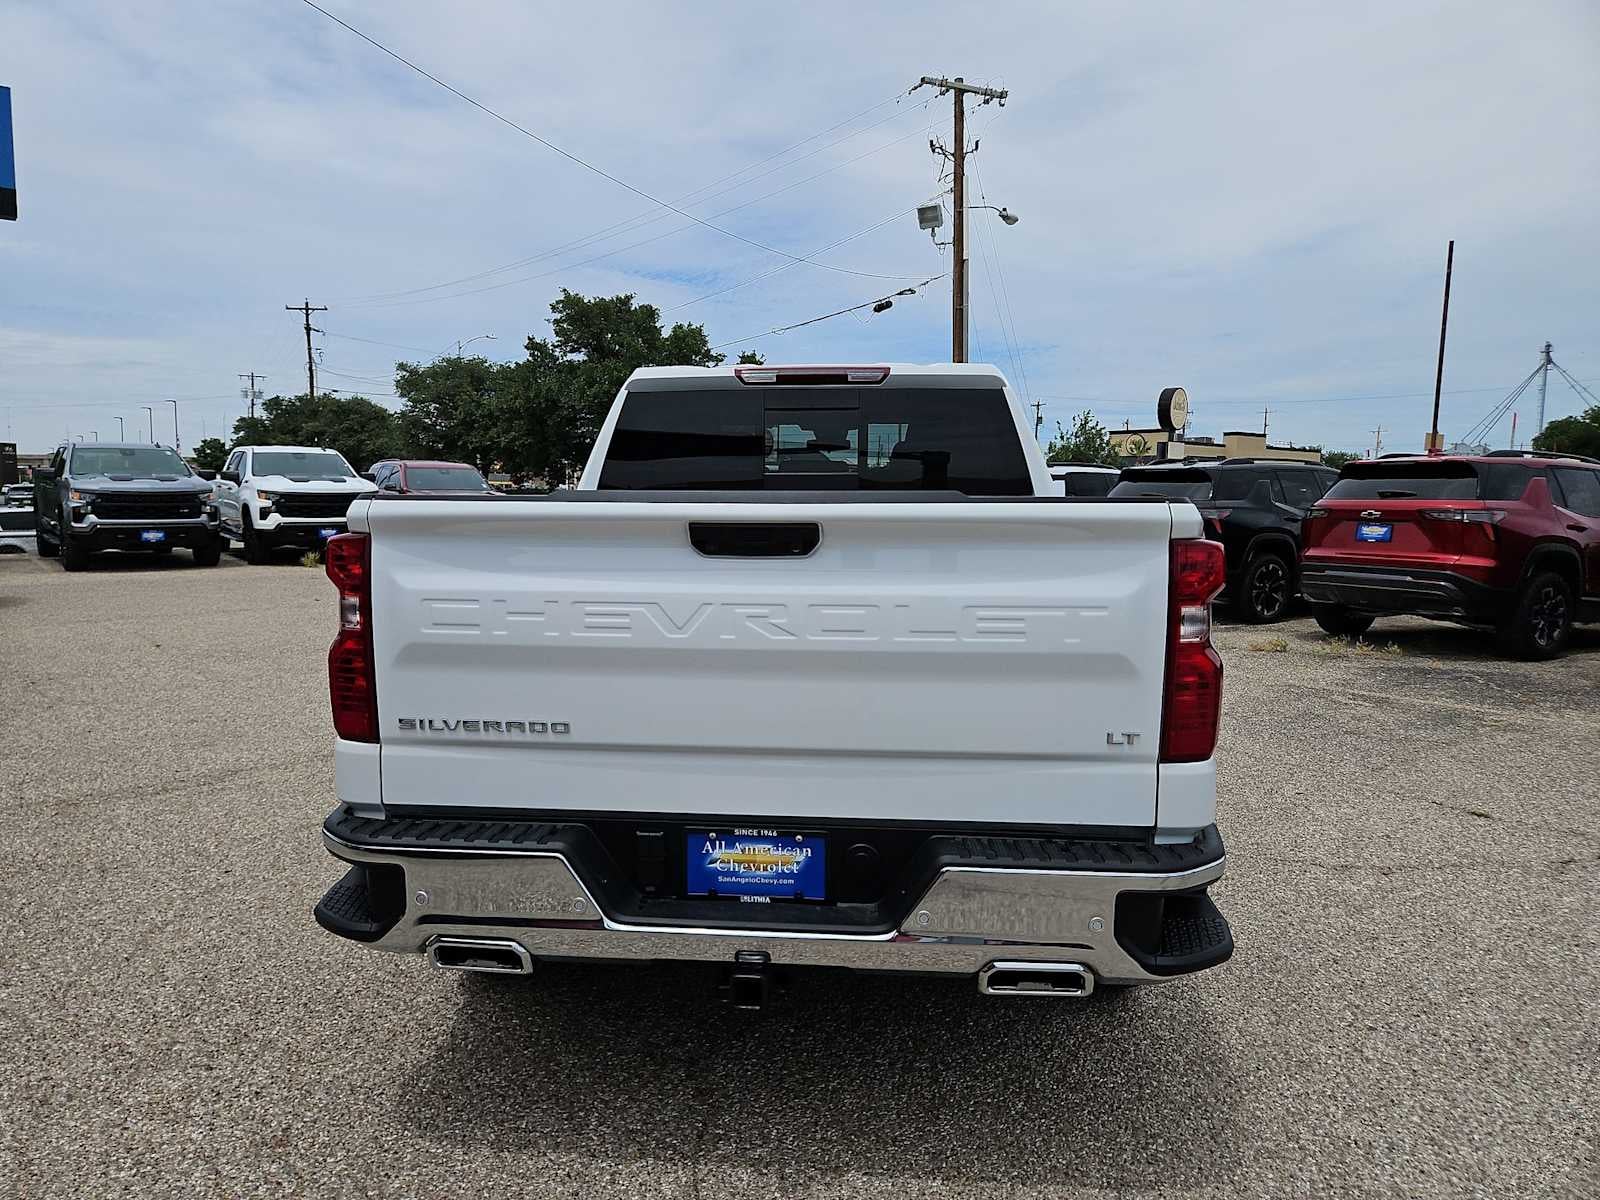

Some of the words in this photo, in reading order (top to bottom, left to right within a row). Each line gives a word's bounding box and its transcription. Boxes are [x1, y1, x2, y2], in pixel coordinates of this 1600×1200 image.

[420, 598, 1109, 642] CHEVROLET
[398, 717, 571, 735] SILVERADO
[1106, 732, 1143, 746] LT
[734, 828, 758, 836] SINCE
[760, 829, 778, 837] 1946
[702, 840, 725, 854] All
[733, 841, 812, 857] American
[716, 858, 800, 874] Chevrolet
[717, 875, 795, 886] SanAngeloChevy.com
[747, 896, 771, 904] LITHIA
